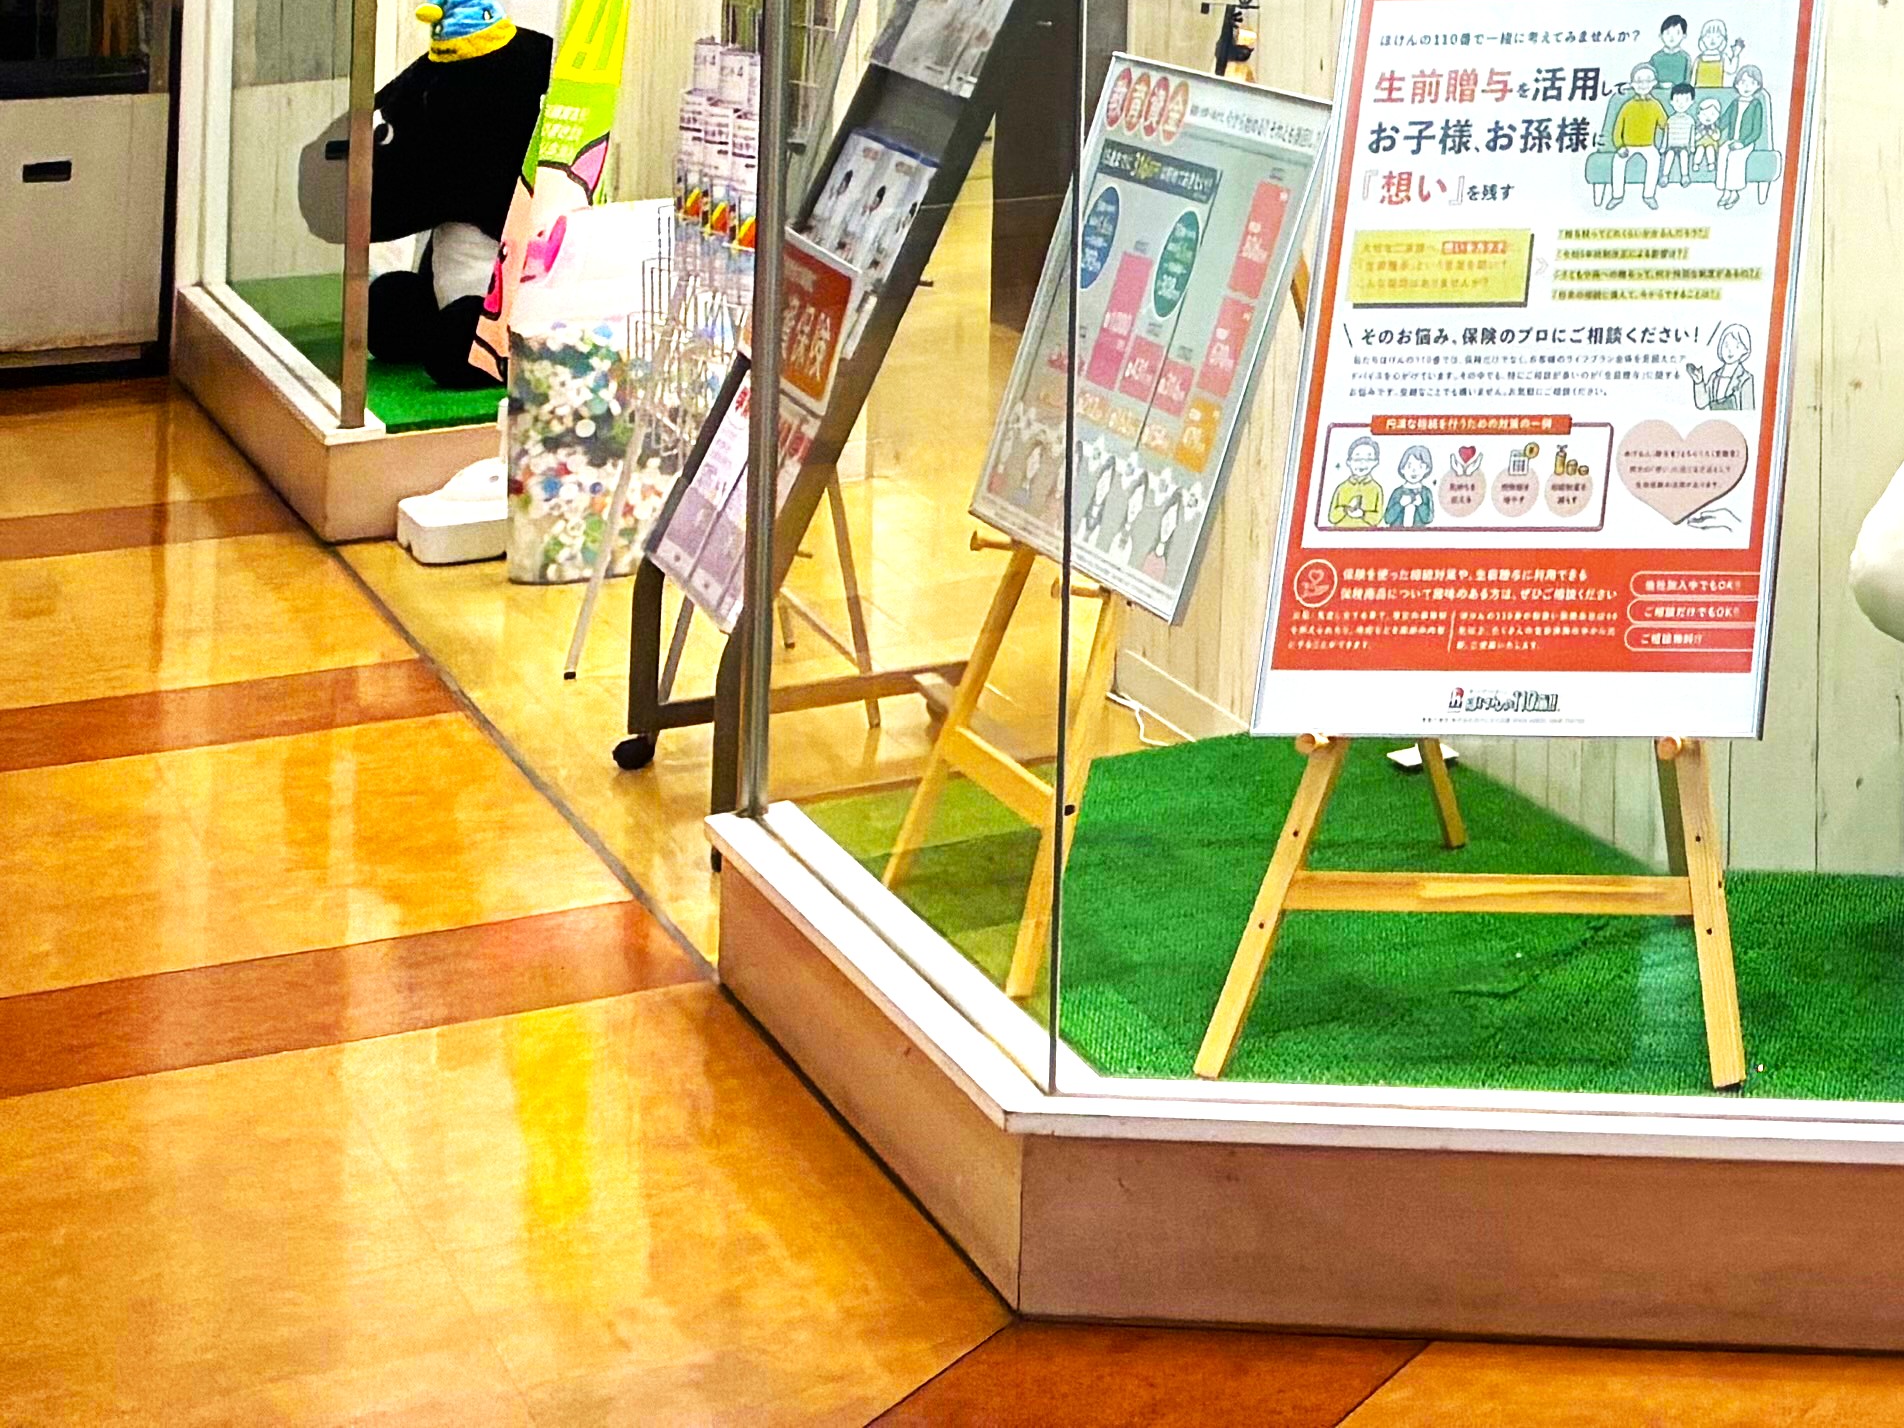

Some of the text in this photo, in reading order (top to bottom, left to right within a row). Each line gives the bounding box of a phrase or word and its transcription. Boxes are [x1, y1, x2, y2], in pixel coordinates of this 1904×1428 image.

[1372, 65, 1629, 105] 生前贈与を活用して
[1366, 116, 1608, 156] お子様、お孫様に
[1360, 168, 1517, 207] 『想い』を残す
[1361, 326, 1699, 345] そのお悩み、保険のプロにご相談ください!
